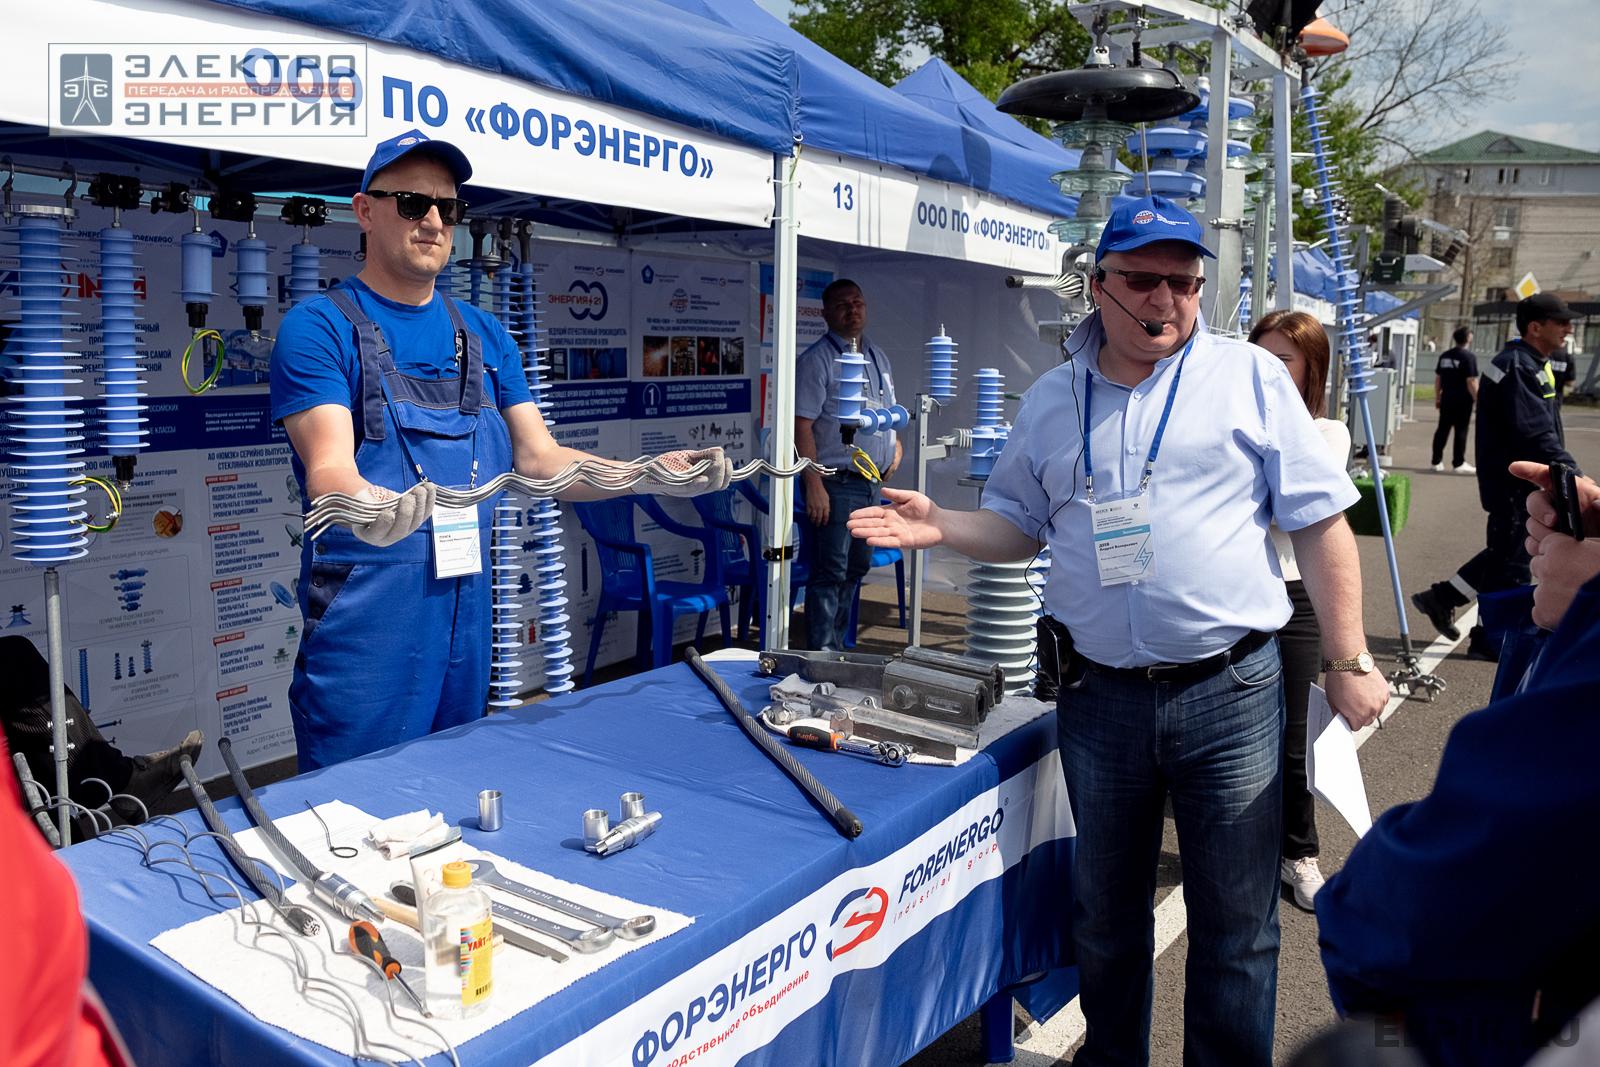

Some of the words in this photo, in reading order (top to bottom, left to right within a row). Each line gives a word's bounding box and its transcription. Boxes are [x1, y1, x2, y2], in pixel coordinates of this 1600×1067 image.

[382, 75, 449, 128] ПО
[464, 101, 714, 179] «ФОРЭНЕРГО»
[833, 182, 853, 211] 13
[917, 201, 947, 228] ООО
[951, 209, 970, 234] ПО
[973, 217, 1051, 251] «ФОРЭНЕРГО»
[548, 294, 590, 305] ЭНЕРГИЯ
[649, 388, 655, 406] 1
[898, 807, 1004, 903] FORENERGO
[893, 873, 951, 925] industrial
[966, 842, 1000, 870] group
[632, 922, 817, 1067] ФОРЭНЕРГО
[742, 970, 810, 1022] объединение
